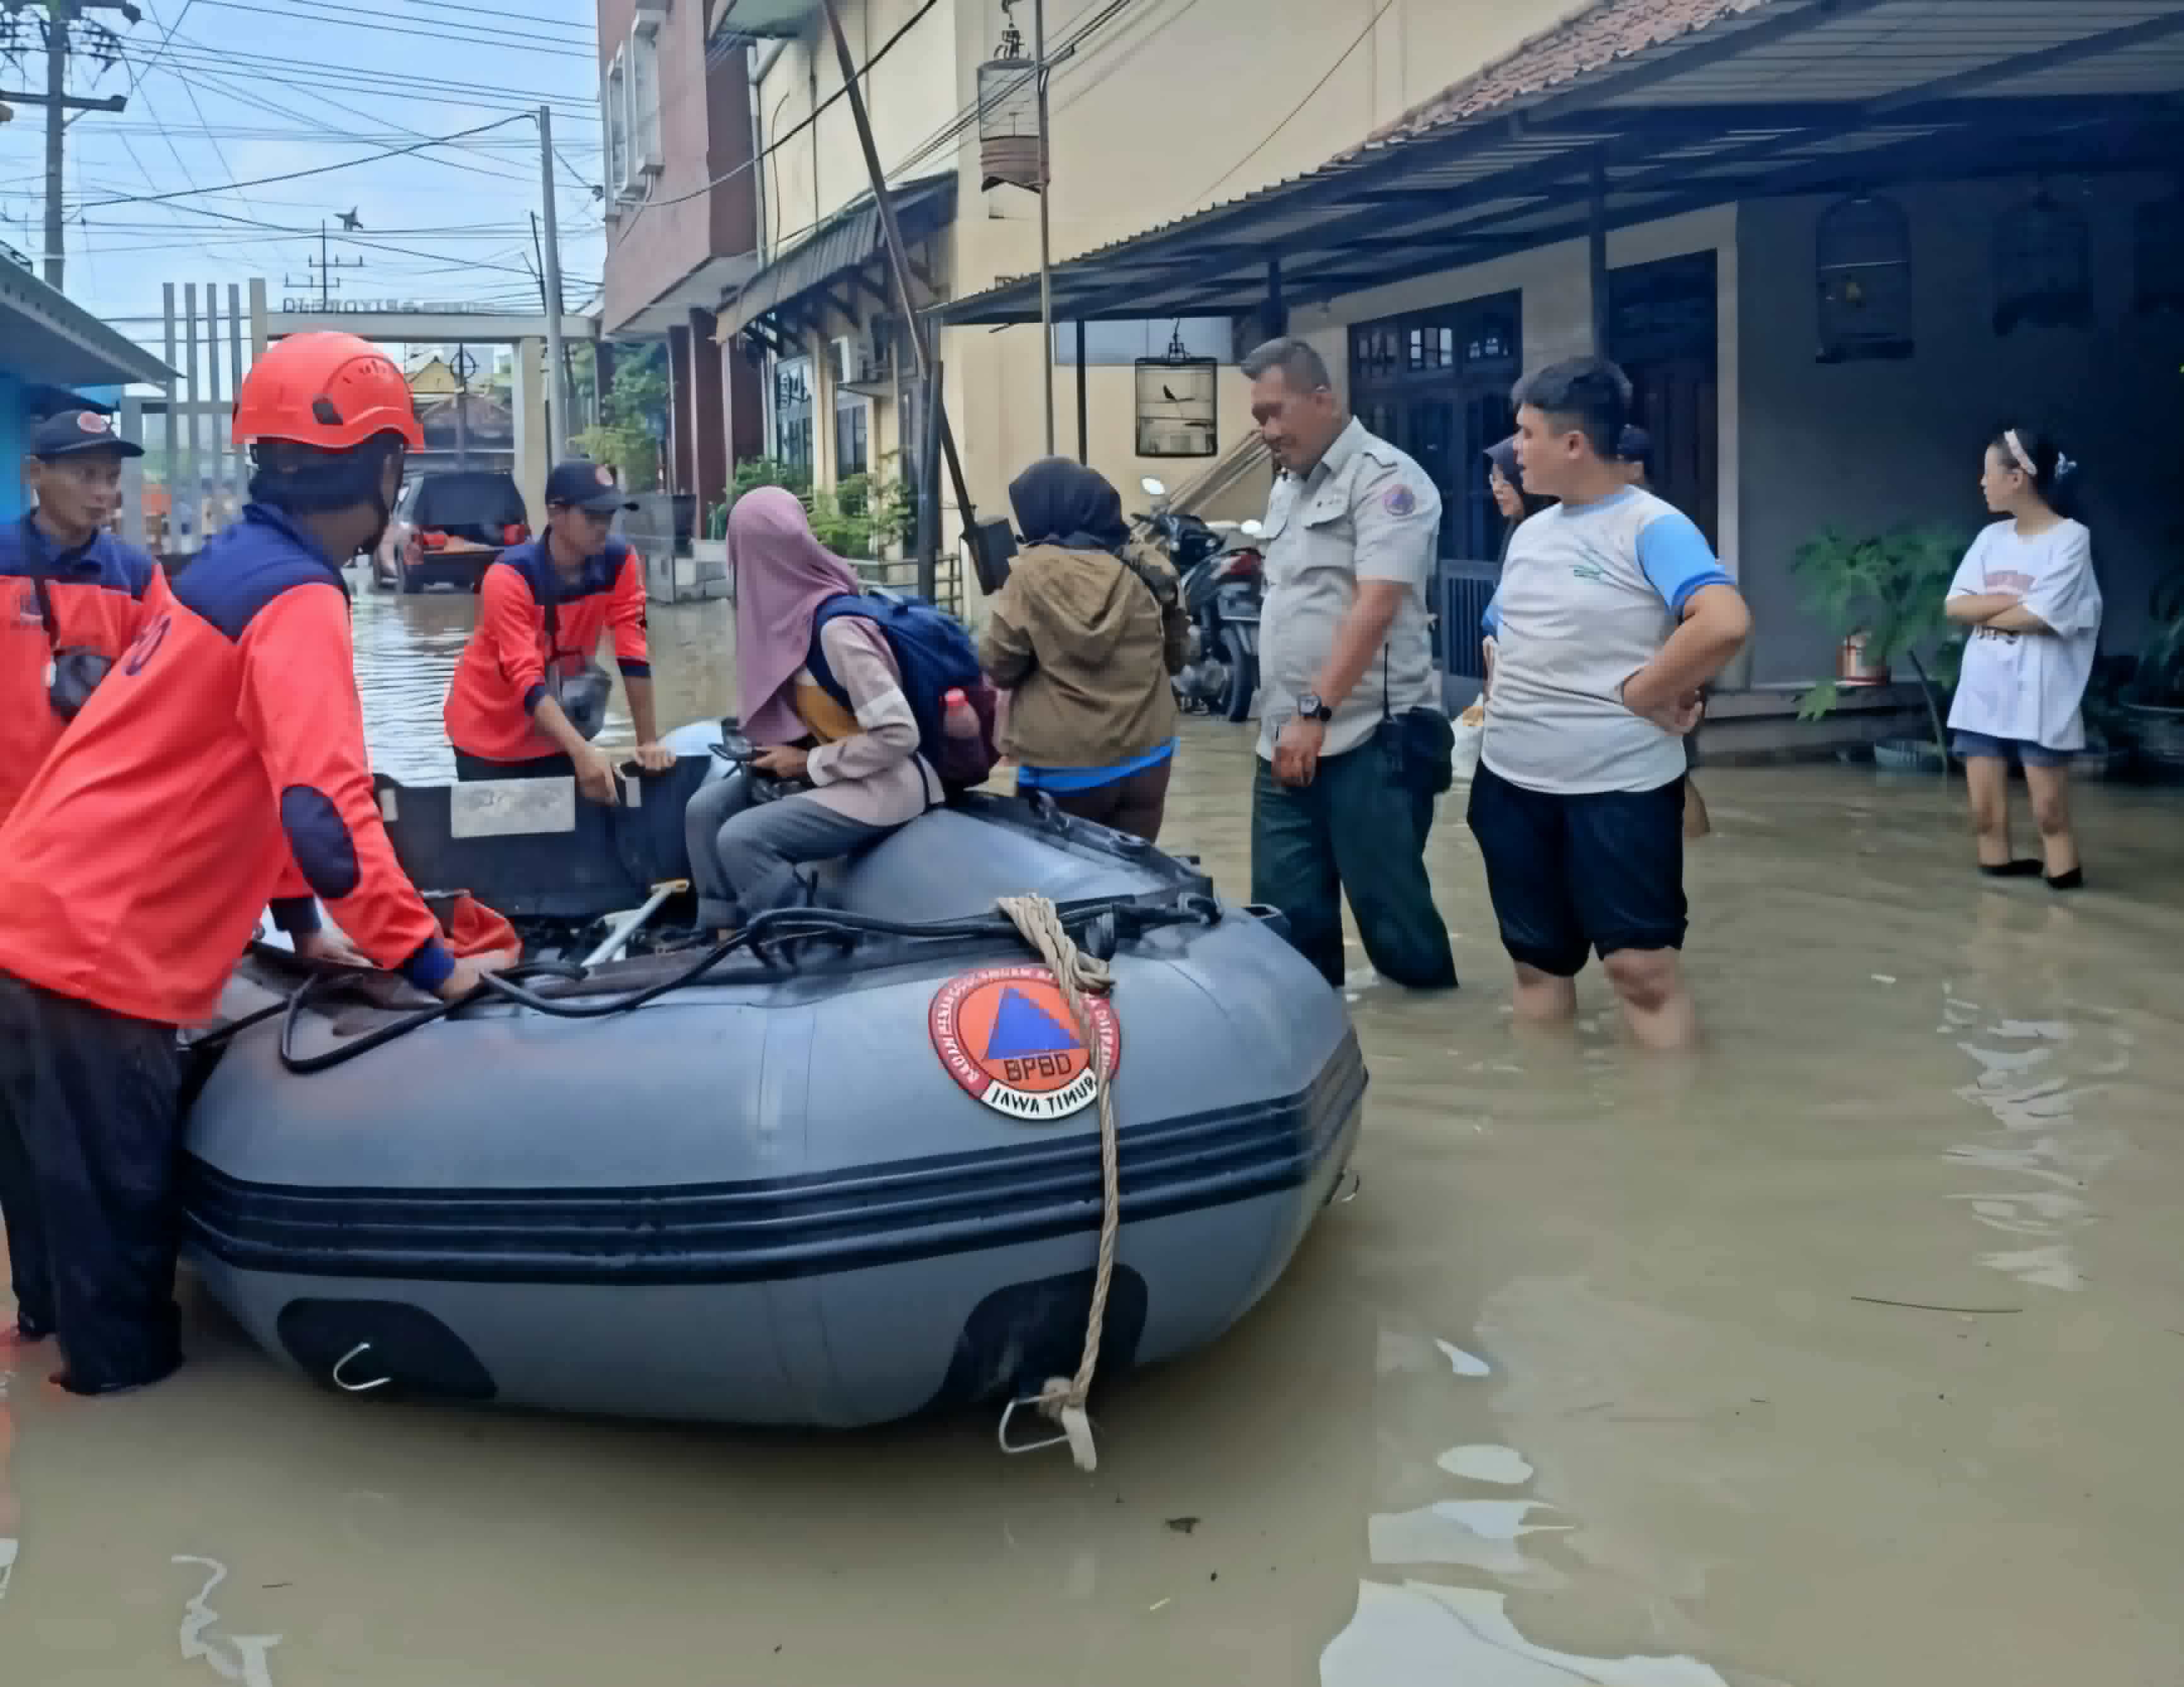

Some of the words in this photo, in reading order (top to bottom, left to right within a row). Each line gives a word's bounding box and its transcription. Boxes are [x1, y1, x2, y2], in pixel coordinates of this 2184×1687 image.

[1004, 1053, 1072, 1081] BPBD
[992, 1088, 1040, 1113] JAWA
[1045, 1076, 1094, 1115] TIMUR
